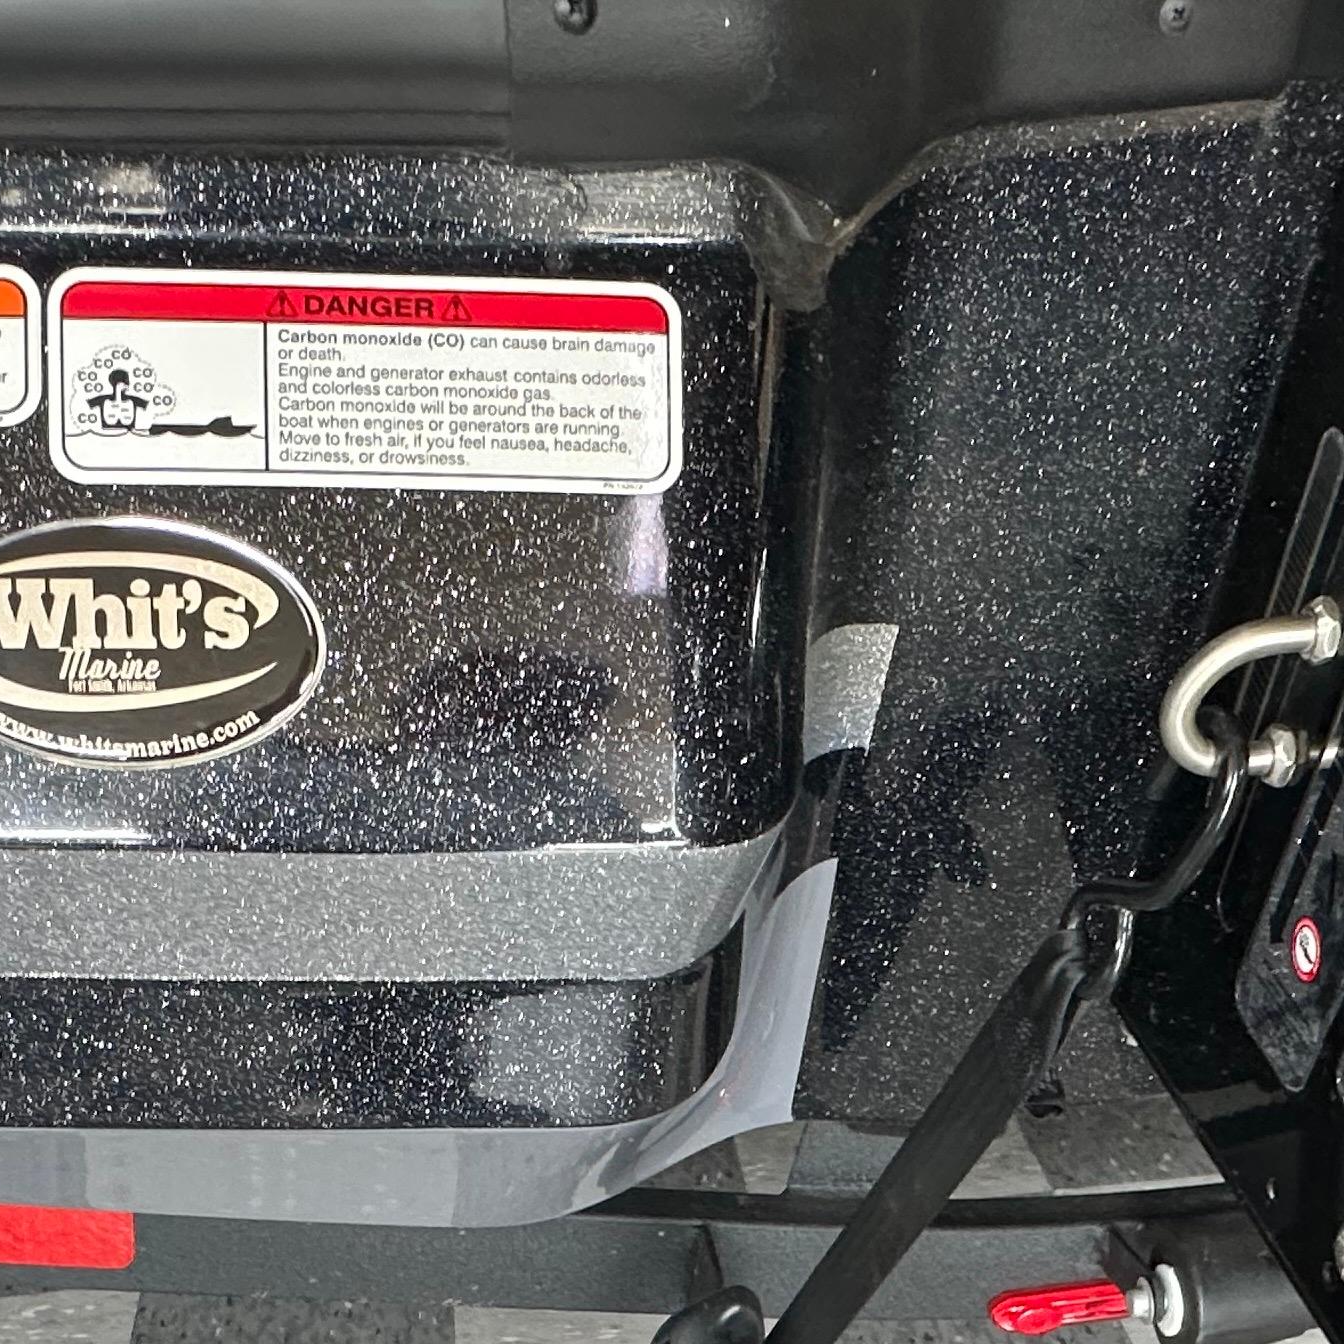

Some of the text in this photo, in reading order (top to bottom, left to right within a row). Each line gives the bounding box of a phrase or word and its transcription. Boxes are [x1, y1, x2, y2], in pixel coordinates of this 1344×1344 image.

[304, 295, 434, 320] DANGER
[278, 329, 656, 358] Carbon monoxide (CO) can cause brain damage
[111, 350, 131, 360] CO
[278, 347, 346, 361] or death.
[94, 359, 113, 369] CO
[78, 371, 98, 382] CO
[133, 367, 153, 378] CO
[278, 363, 646, 387] Engine and generator exhaust contains odorless
[84, 383, 103, 393] CO
[133, 382, 154, 393] CO
[278, 381, 307, 395] and
[312, 382, 381, 396] colorless
[385, 383, 439, 398] carbon
[444, 385, 518, 400] monoxide
[153, 396, 172, 406] CO
[279, 397, 642, 420] Carbon monoxide will be around the back of the
[78, 413, 98, 423] CO
[279, 414, 314, 429] boat
[317, 415, 359, 430] when
[364, 418, 424, 433] engines
[428, 419, 444, 431] or
[449, 420, 530, 435] generators
[535, 423, 559, 434] are
[279, 430, 321, 446] Move
[325, 432, 340, 446] to
[345, 433, 382, 447] fresh
[387, 435, 409, 450] air,
[426, 437, 455, 453] you
[459, 435, 486, 449] feel
[491, 437, 550, 454] nausea,
[554, 438, 632, 456] headache,
[279, 447, 470, 466] dizziness, or drowsiness.
[58, 647, 161, 680] Marine
